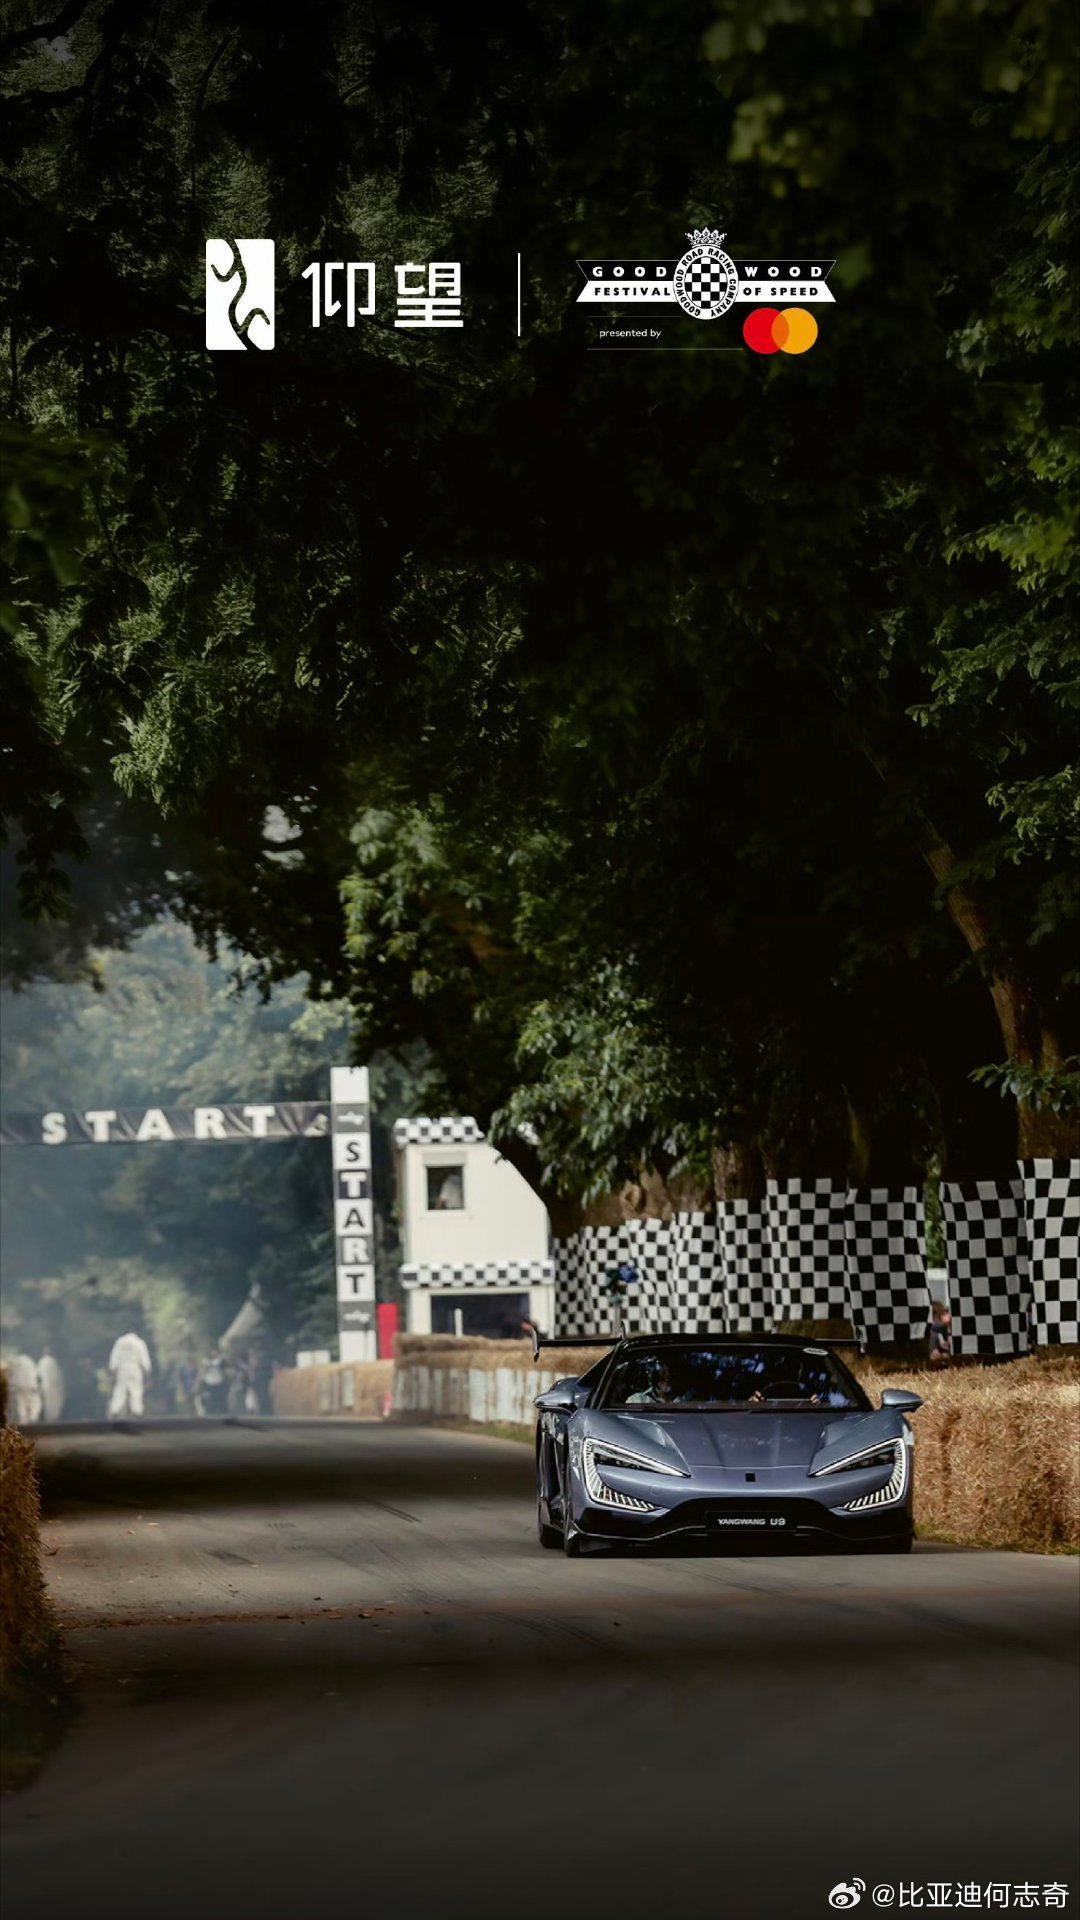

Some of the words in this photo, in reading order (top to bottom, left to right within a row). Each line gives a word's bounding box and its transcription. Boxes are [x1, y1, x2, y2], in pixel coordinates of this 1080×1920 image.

[42, 1105, 275, 1145] START
[340, 1141, 370, 1294] START
[717, 1518, 766, 1526] YANGWANG
[770, 1518, 786, 1526] U9
